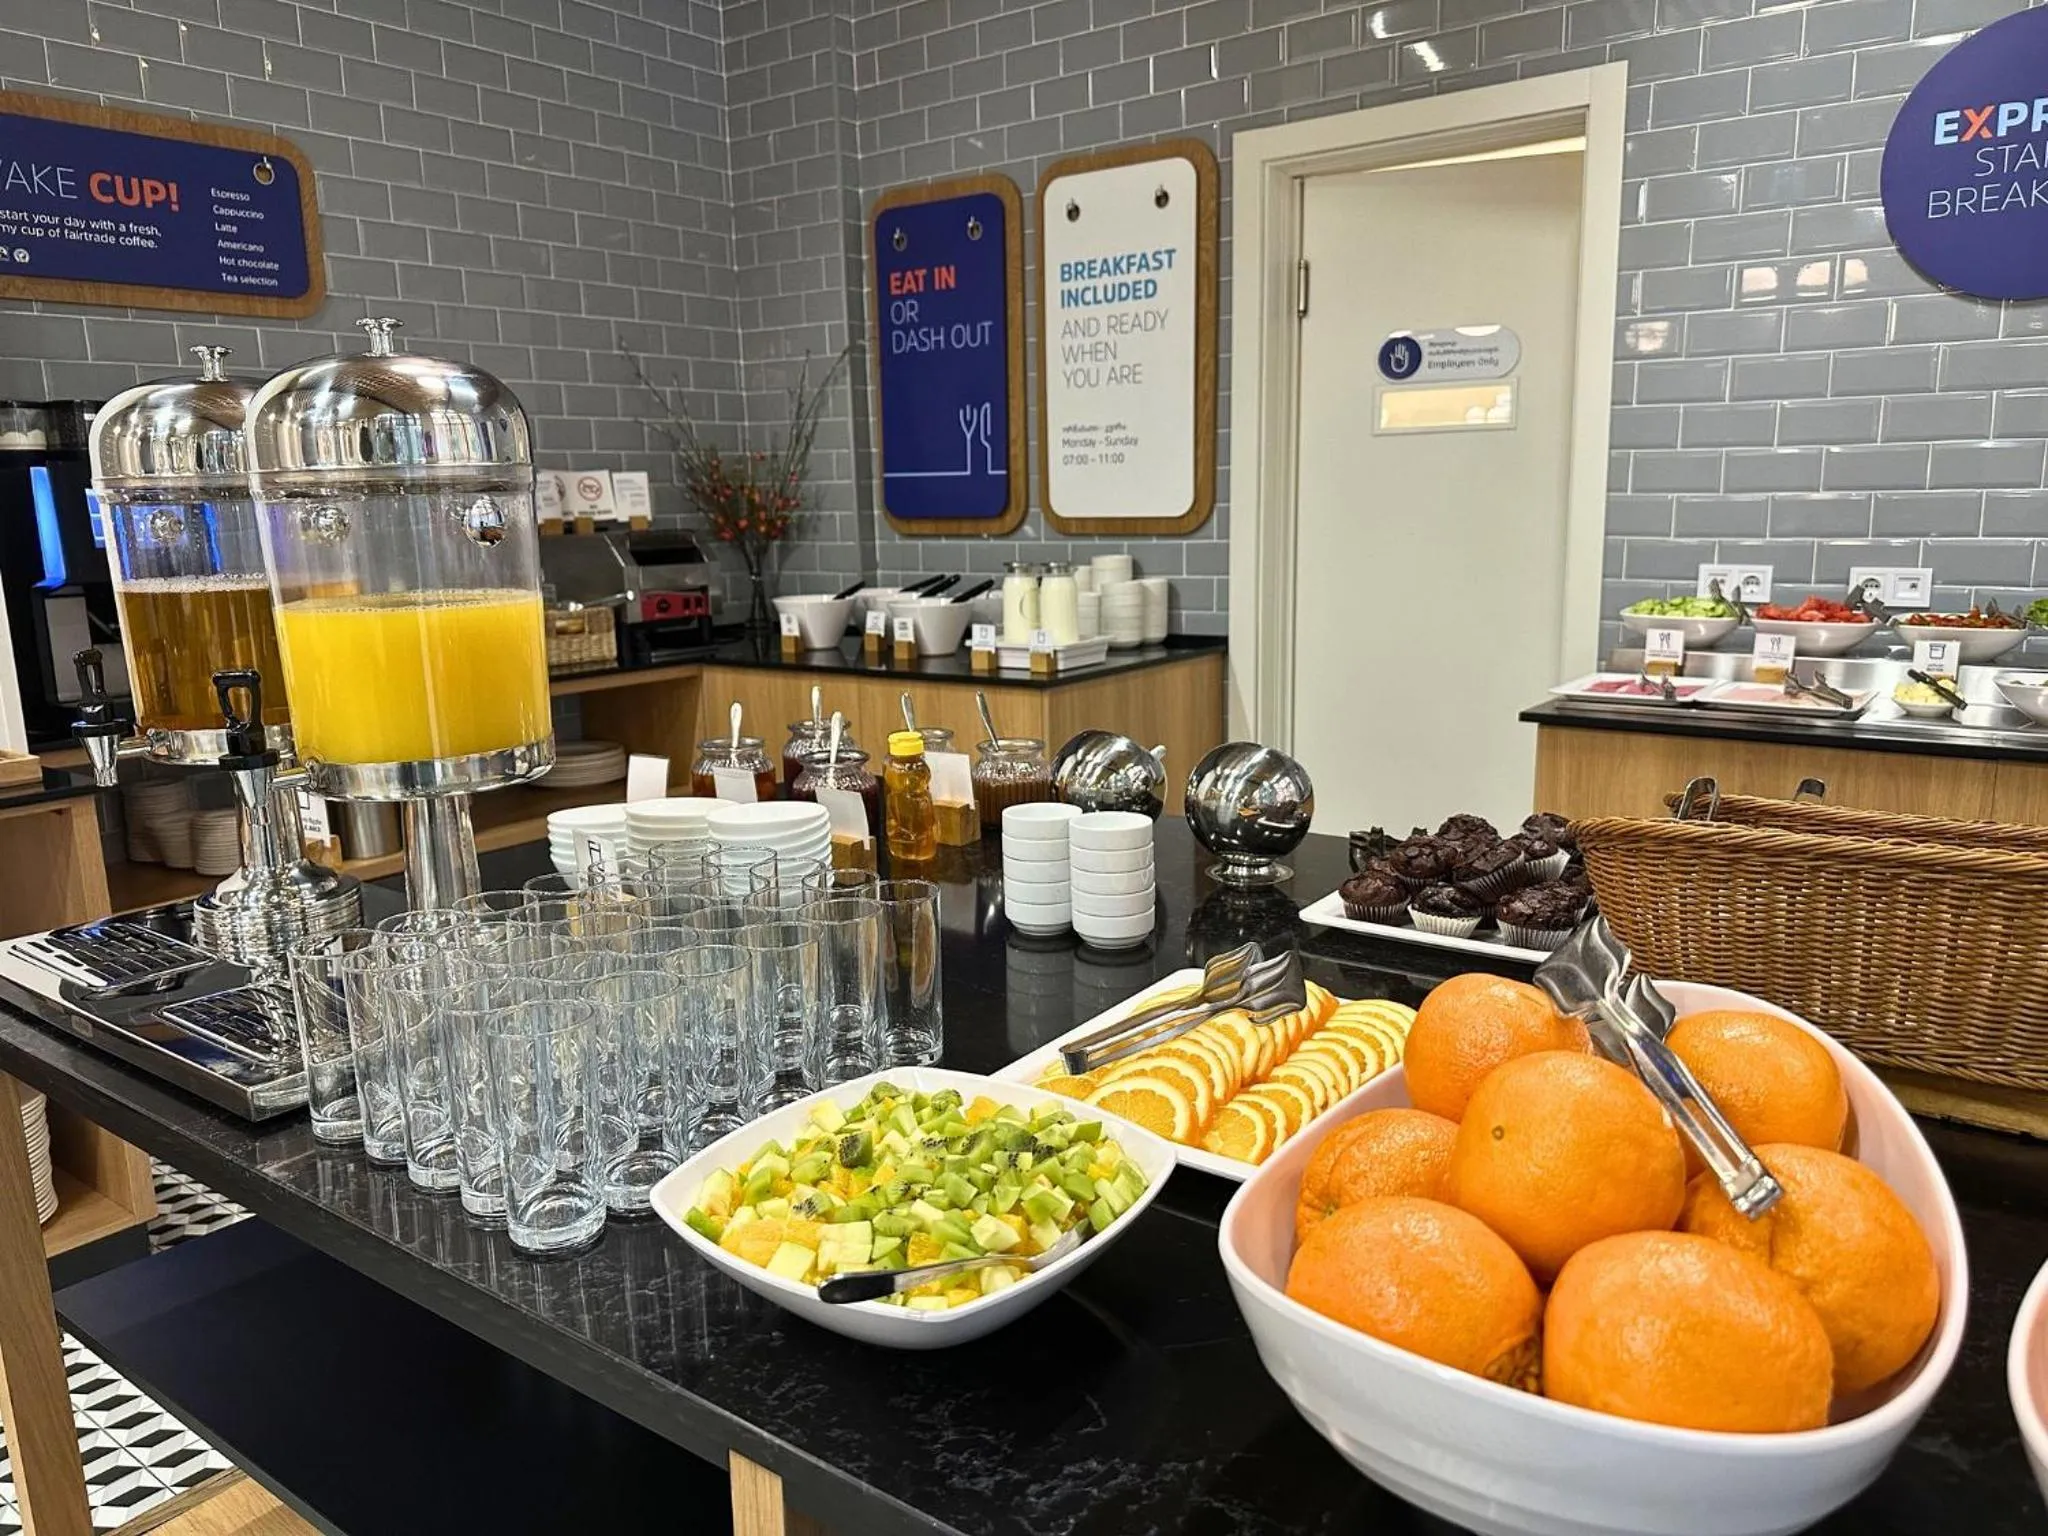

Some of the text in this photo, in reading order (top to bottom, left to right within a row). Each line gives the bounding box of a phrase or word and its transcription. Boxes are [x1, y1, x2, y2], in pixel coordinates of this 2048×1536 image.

[1974, 142, 2048, 177] STA
[0, 159, 180, 212] AKE CUP!
[211, 187, 250, 201] Espresso
[1928, 180, 2048, 219] BREAK
[32, 214, 60, 225] your
[63, 216, 86, 229] day
[89, 218, 116, 231] with
[118, 222, 127, 233] a
[212, 204, 265, 220] Cappuccino
[21, 225, 45, 237] cup
[48, 227, 61, 238] of
[64, 229, 116, 244] fairtrade
[119, 234, 158, 248] coffee.
[215, 222, 238, 234] Latte
[218, 239, 265, 253] Americano
[219, 256, 279, 271] Hot chocolate
[1060, 248, 1177, 282] BREAKFAST
[221, 273, 278, 287] Tea selection
[889, 264, 956, 296] EAT IN
[1060, 279, 1158, 309] INCLUDED
[890, 299, 919, 326] OR
[1060, 308, 1169, 340] AND READY
[891, 321, 993, 354] DASH OUT
[1060, 341, 1117, 365] WHEN
[1427, 358, 1475, 370] Employees
[1062, 363, 1143, 390] YOU ARE
[1104, 435, 1139, 448] Sunday
